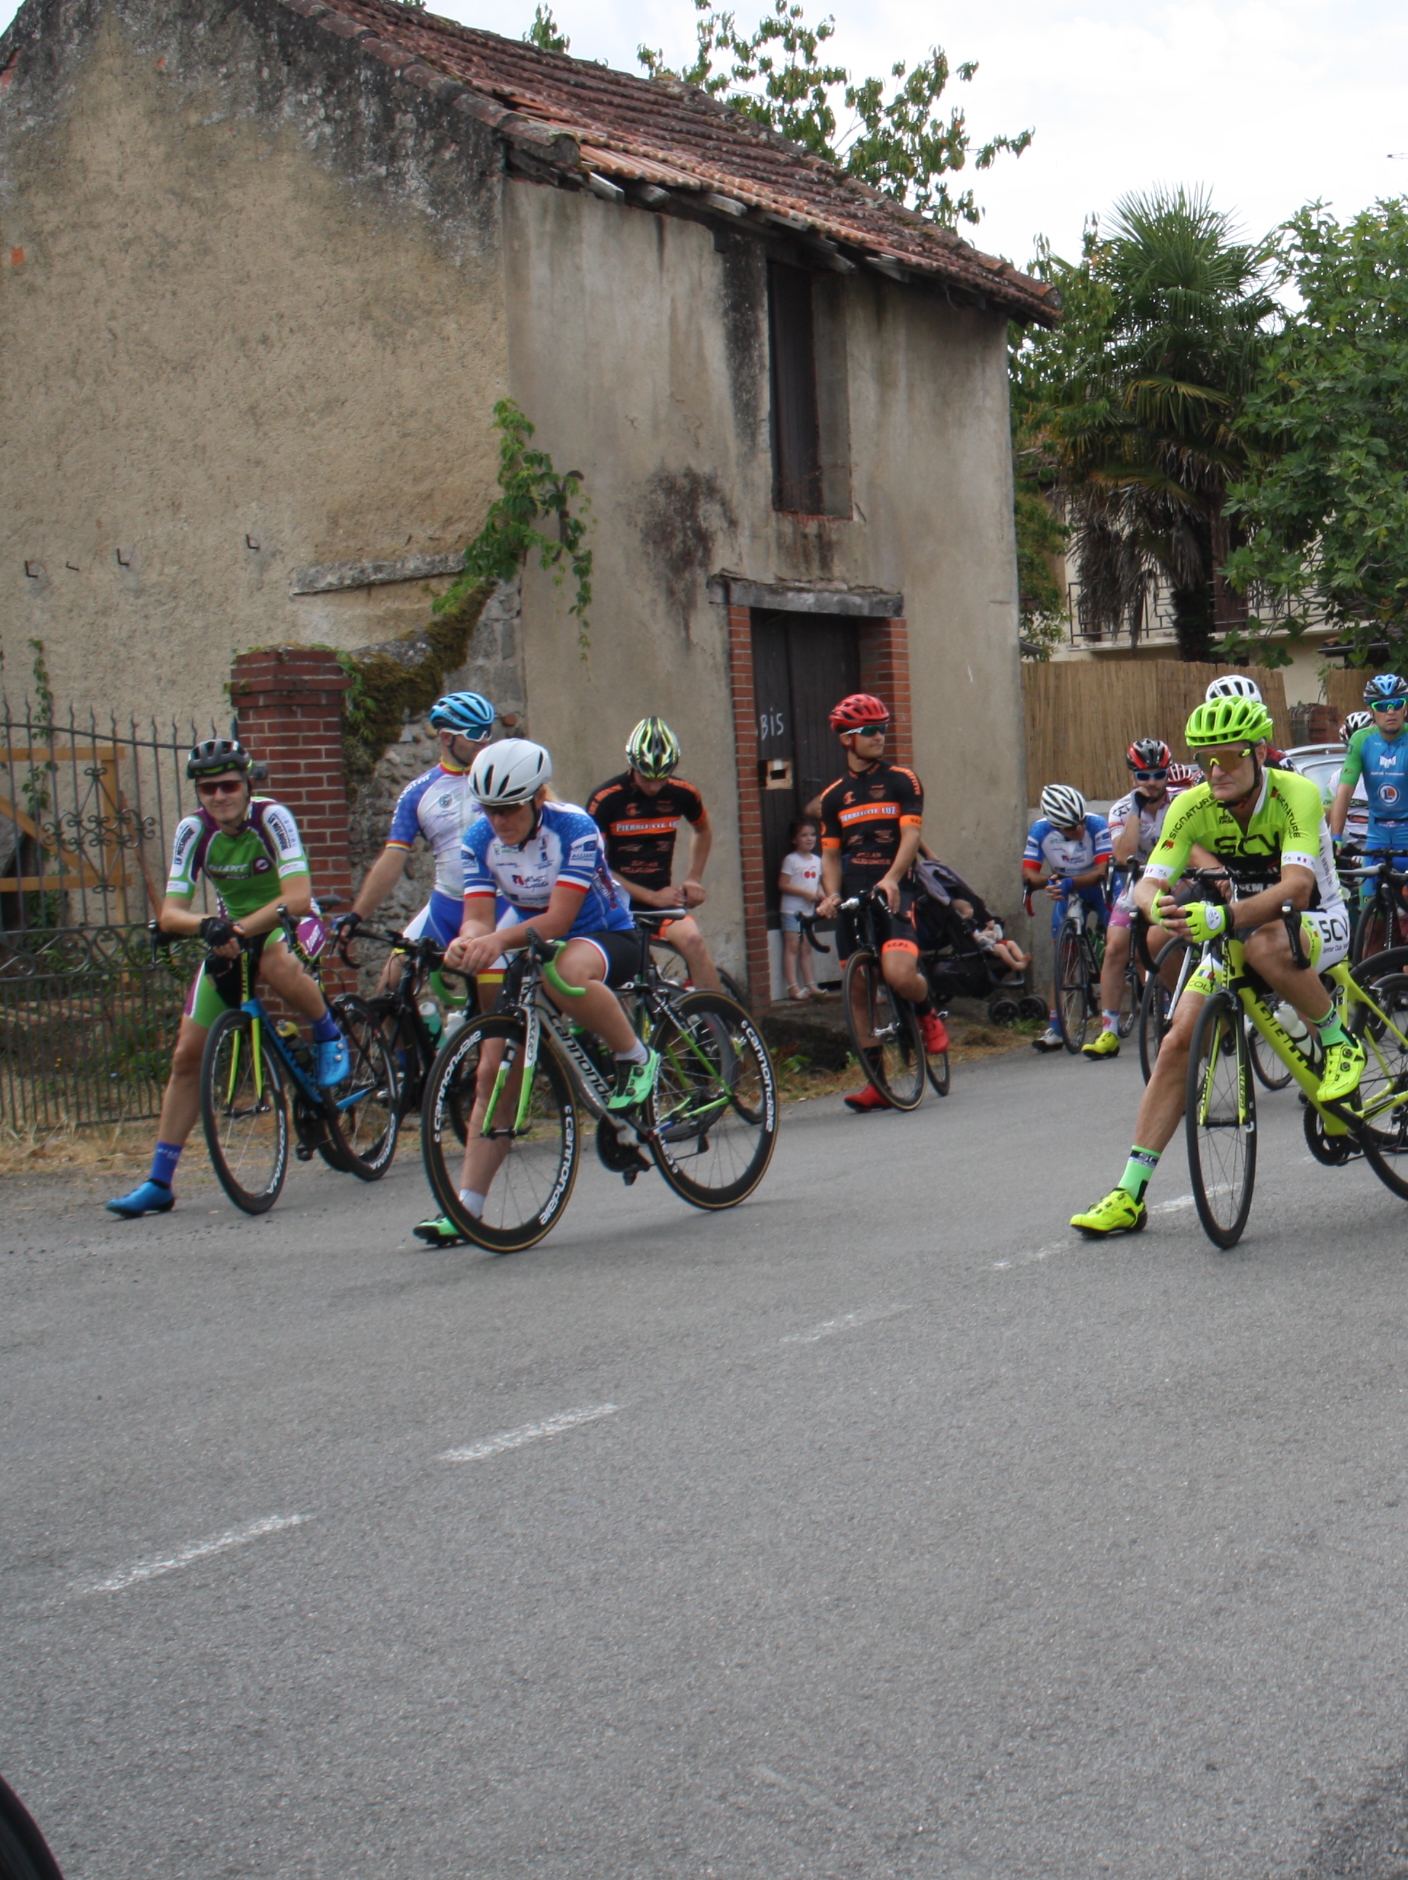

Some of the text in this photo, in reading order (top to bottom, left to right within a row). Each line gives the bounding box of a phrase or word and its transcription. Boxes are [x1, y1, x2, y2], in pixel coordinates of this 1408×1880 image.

[1169, 793, 1216, 840] SIGNATURE
[1276, 793, 1301, 839] SIGNATURE
[434, 1030, 482, 1131] cannondale
[745, 1027, 774, 1133] cannondale
[539, 1116, 574, 1226] cannondale
